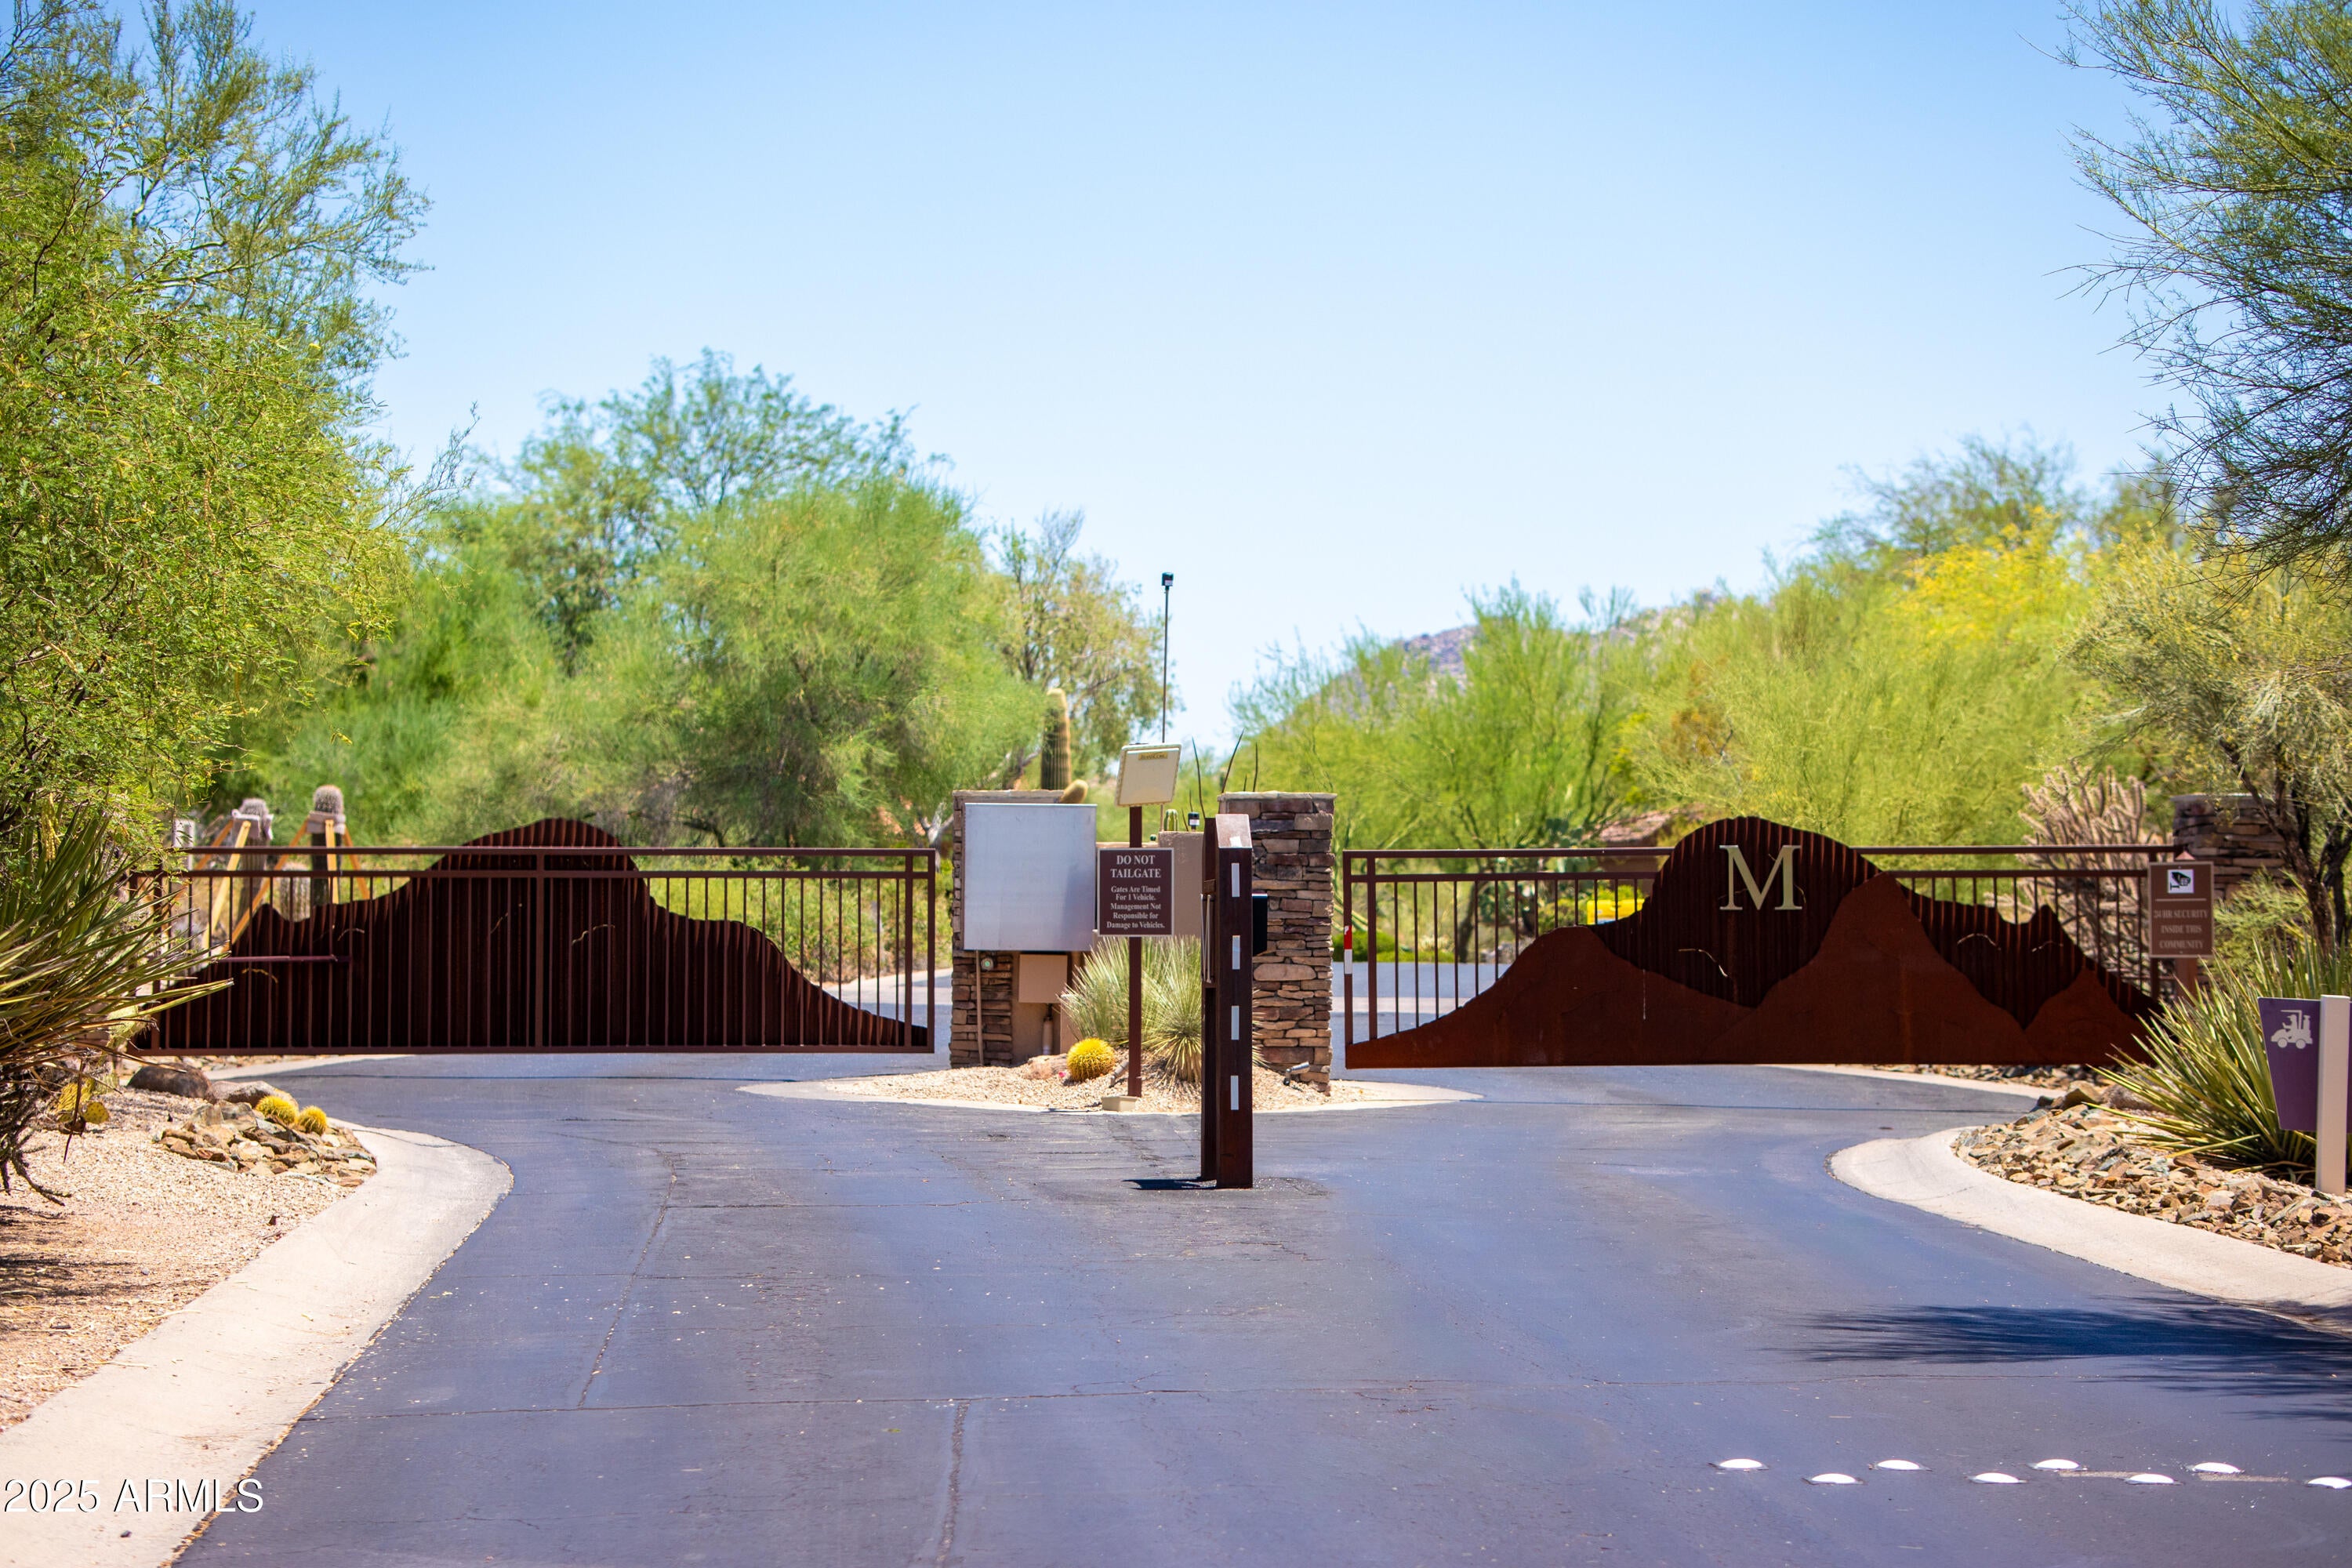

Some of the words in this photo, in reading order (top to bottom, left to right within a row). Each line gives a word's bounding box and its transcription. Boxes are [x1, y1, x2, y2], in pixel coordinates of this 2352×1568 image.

[1116, 855, 1131, 865] DO
[1134, 855, 1156, 865] NOT
[1110, 869, 1161, 878] TAILGATE
[1719, 845, 1802, 910] M
[2174, 909, 2208, 918] SECURITY
[2161, 924, 2183, 934] INSIDE
[2186, 924, 2202, 934] THIS
[2159, 940, 2204, 949] COMMUNITY
